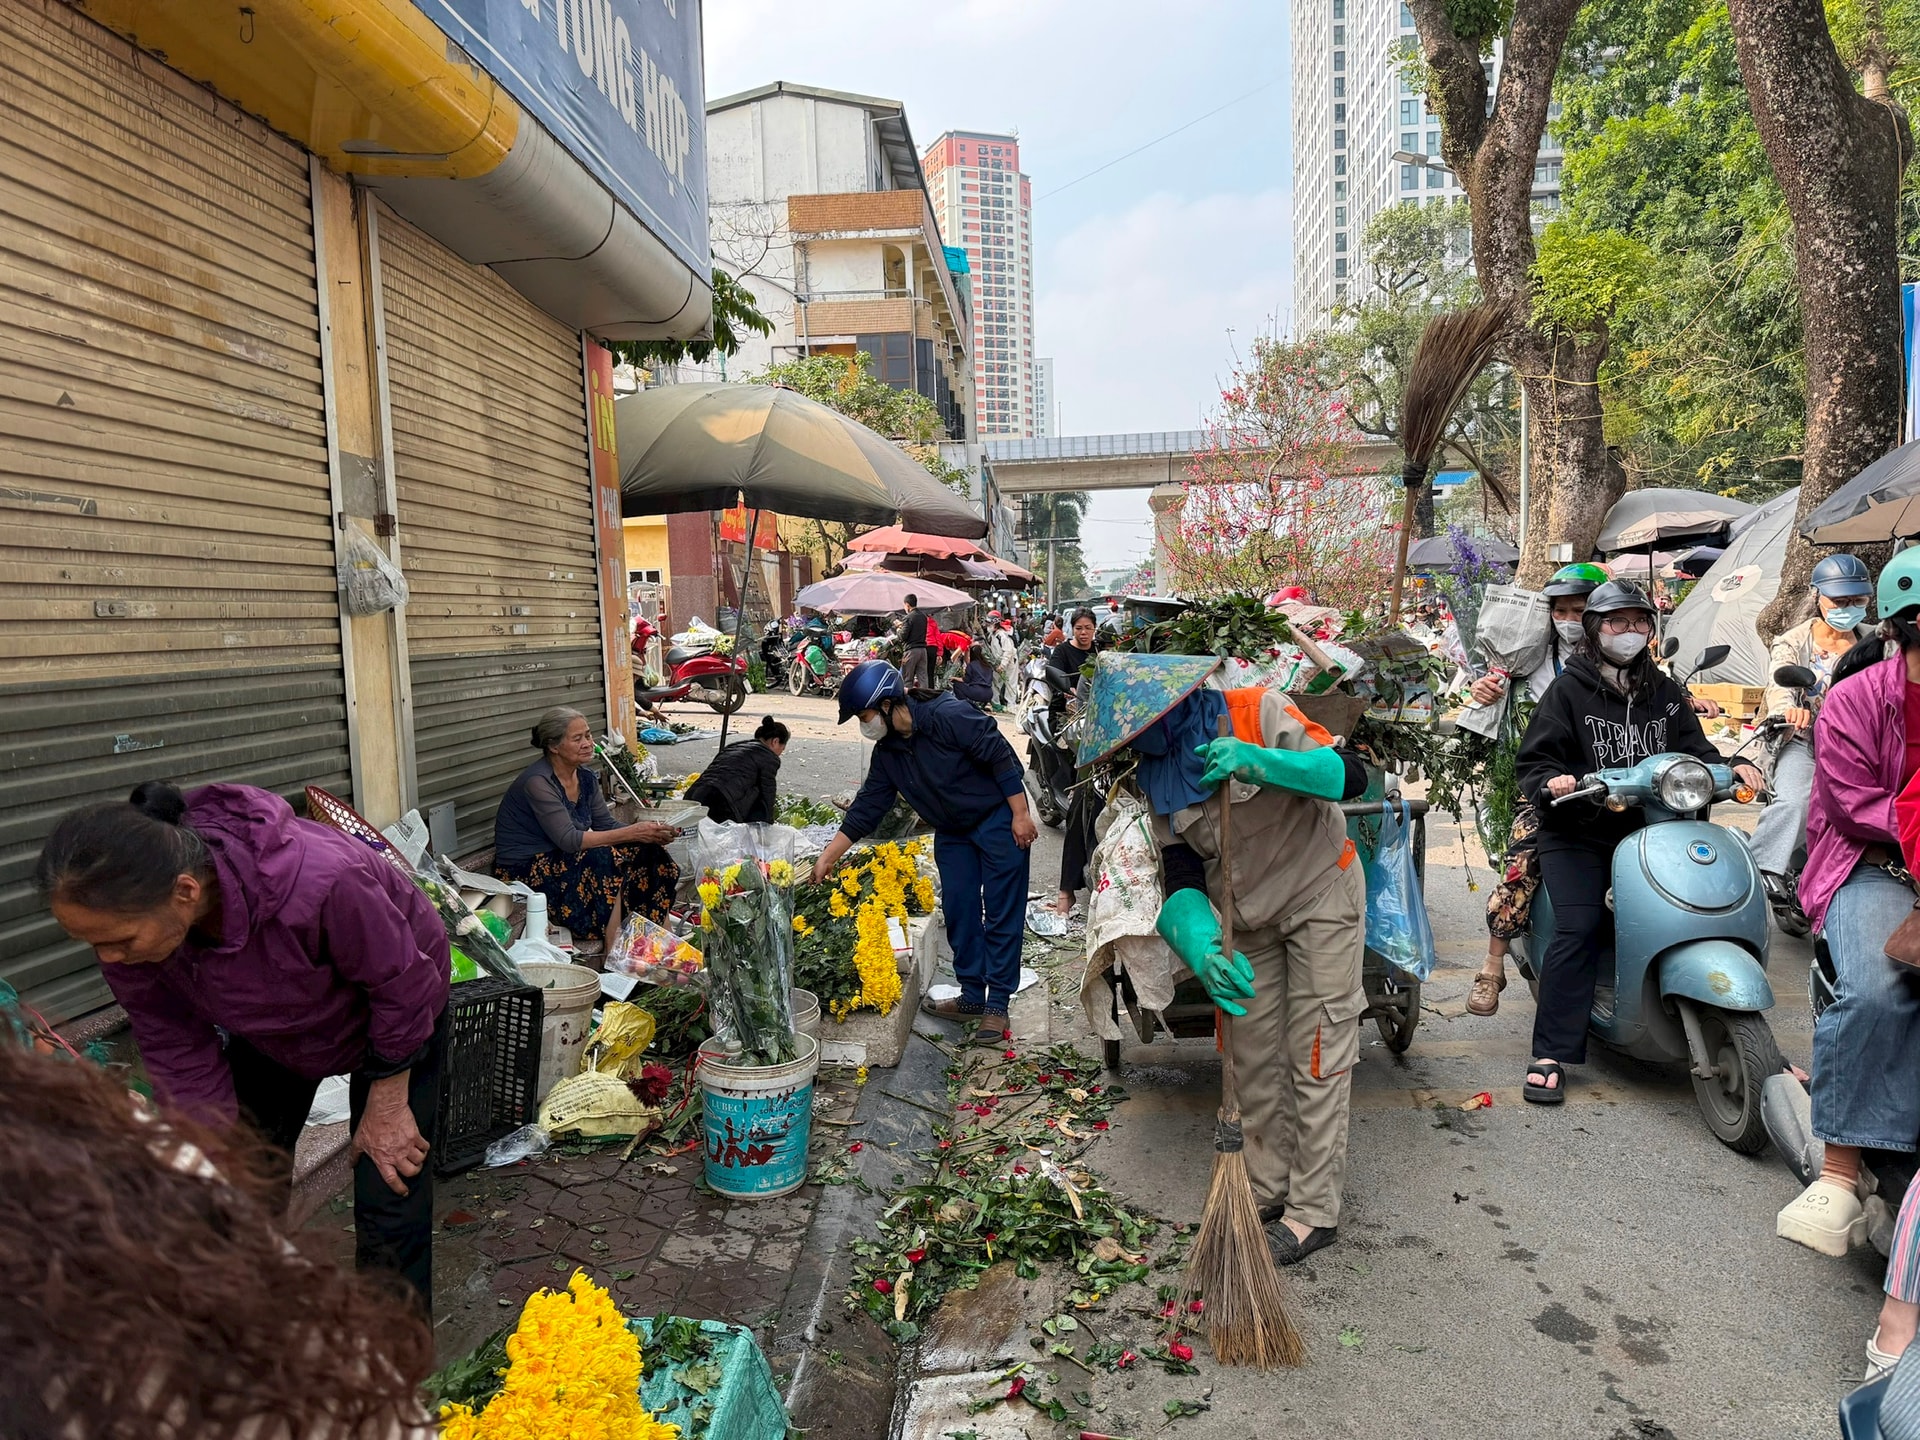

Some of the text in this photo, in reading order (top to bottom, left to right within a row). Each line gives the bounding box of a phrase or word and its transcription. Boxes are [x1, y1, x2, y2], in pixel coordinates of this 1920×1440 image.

[641, 47, 689, 197] HỢP
[609, 557, 622, 599] TO
[711, 1100, 741, 1113] LUBEC
